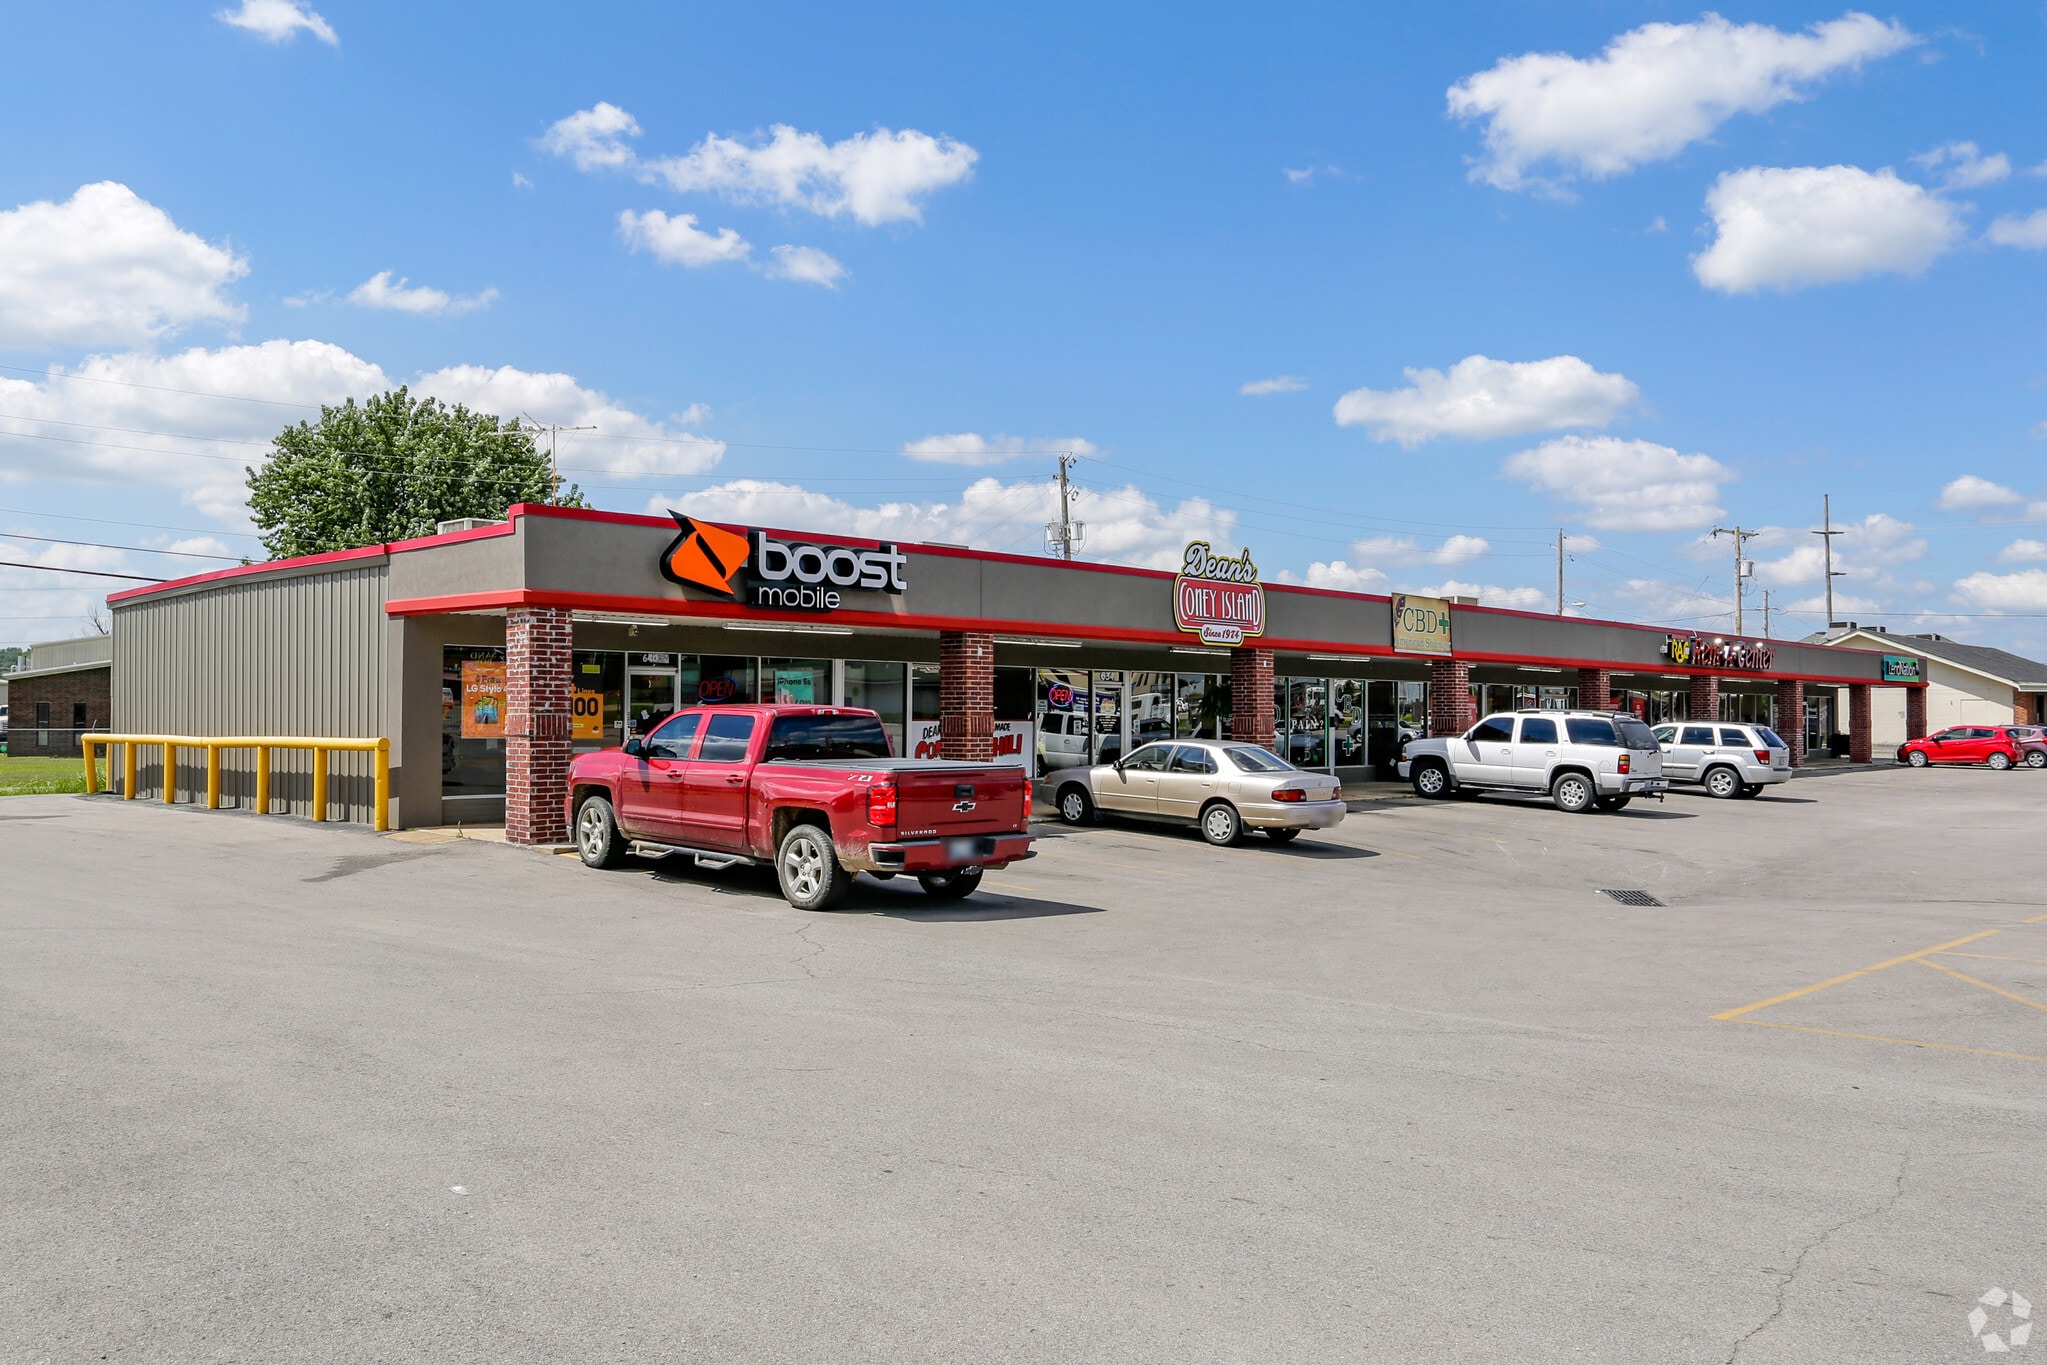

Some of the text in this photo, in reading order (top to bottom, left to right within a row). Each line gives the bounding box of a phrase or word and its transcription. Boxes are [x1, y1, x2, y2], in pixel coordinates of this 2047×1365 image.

[759, 531, 907, 590] boost
[1184, 543, 1256, 583] Dean's
[759, 587, 840, 609] mobile
[1180, 581, 1261, 625] CONEY ISLAND
[1203, 627, 1239, 639] Since 1974
[777, 677, 811, 685] iPhone 6s
[1101, 672, 1114, 680] 634
[466, 684, 478, 692] LG
[480, 684, 502, 695] Stylo
[699, 680, 735, 697] OPEN
[1052, 689, 1072, 701] OPEN
[993, 733, 1023, 757] HILI
